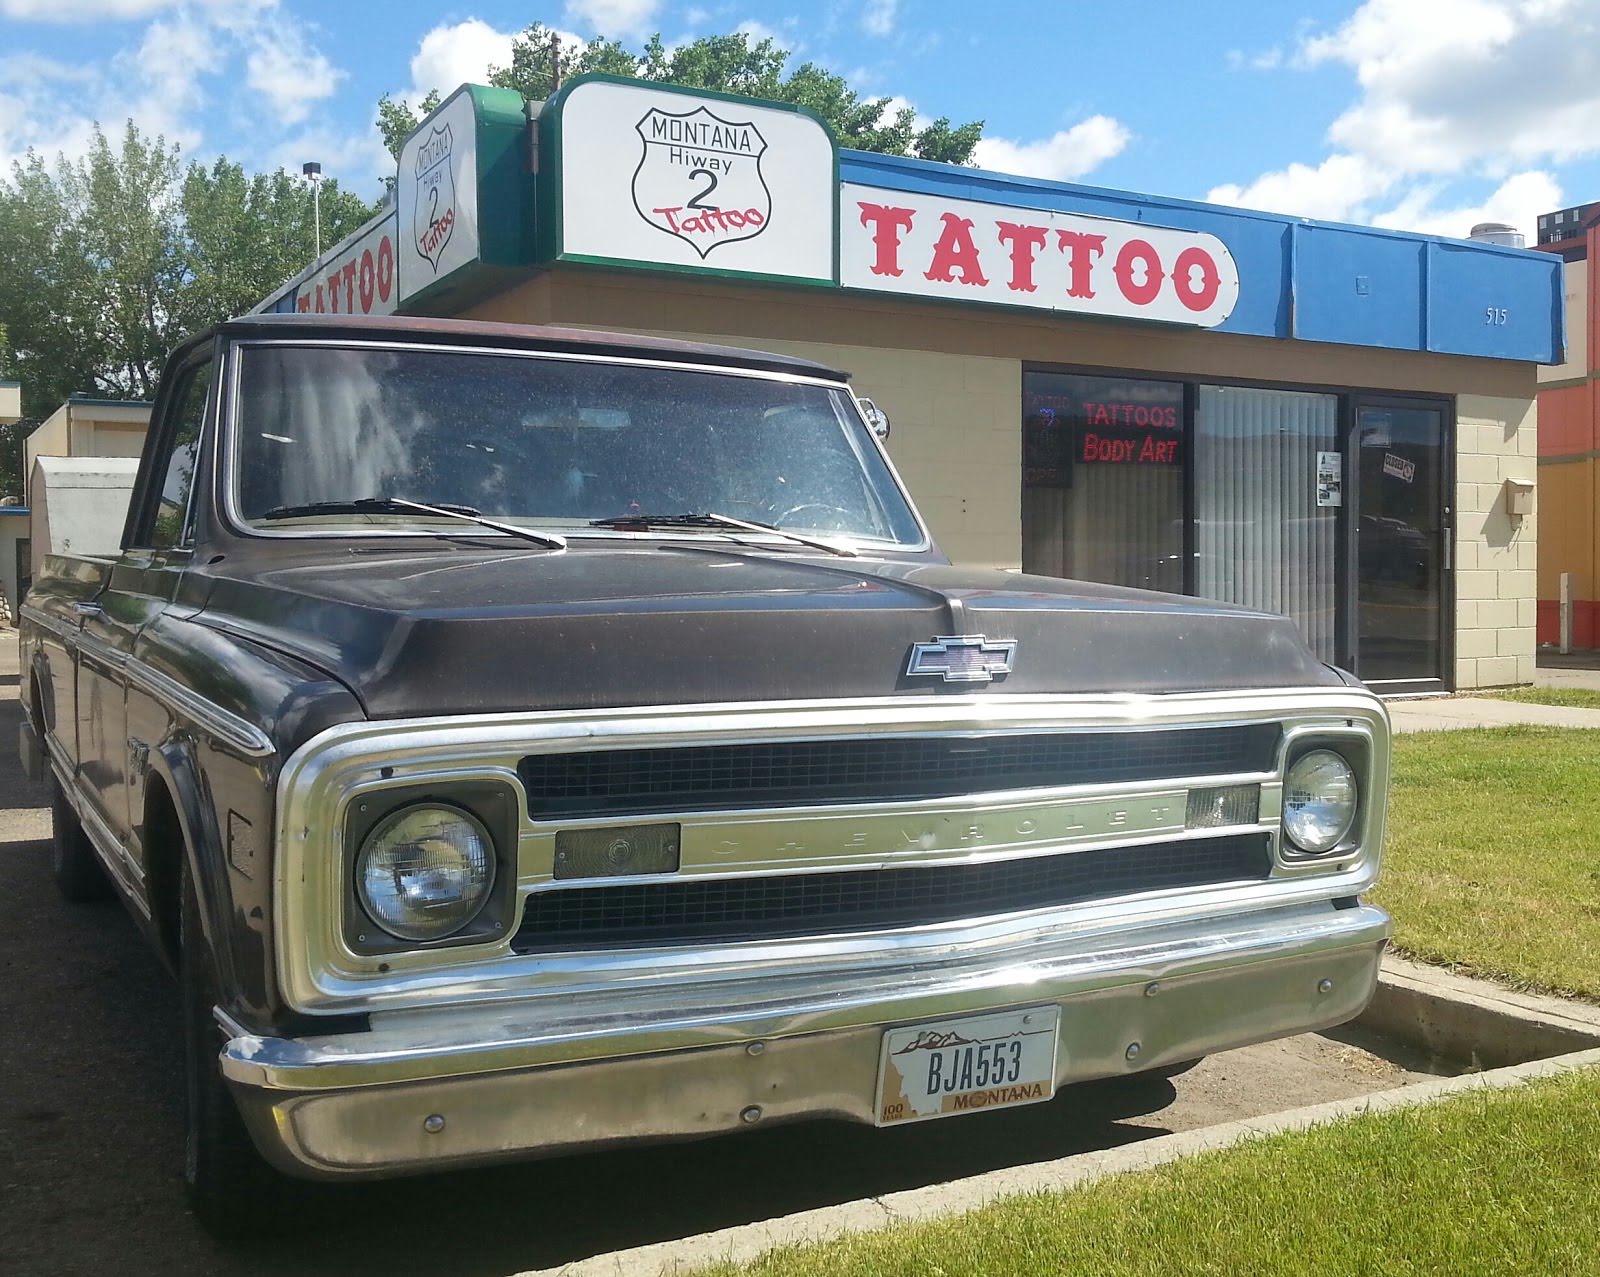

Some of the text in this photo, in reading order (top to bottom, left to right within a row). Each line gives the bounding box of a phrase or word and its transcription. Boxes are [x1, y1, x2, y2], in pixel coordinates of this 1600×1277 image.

[652, 116, 752, 152] MONTANA
[669, 146, 733, 176] Hiway
[686, 168, 720, 212] 2
[428, 186, 442, 230] 2
[652, 206, 765, 235] Tattoo
[419, 207, 454, 257] Tattoo
[856, 201, 1222, 312] TATTOO
[1485, 307, 1508, 326] 515
[1084, 403, 1176, 428] TATTOOS
[927, 1041, 1021, 1095] BJA553
[883, 1103, 904, 1116] 100
[953, 1083, 1042, 1109] MONTANA
